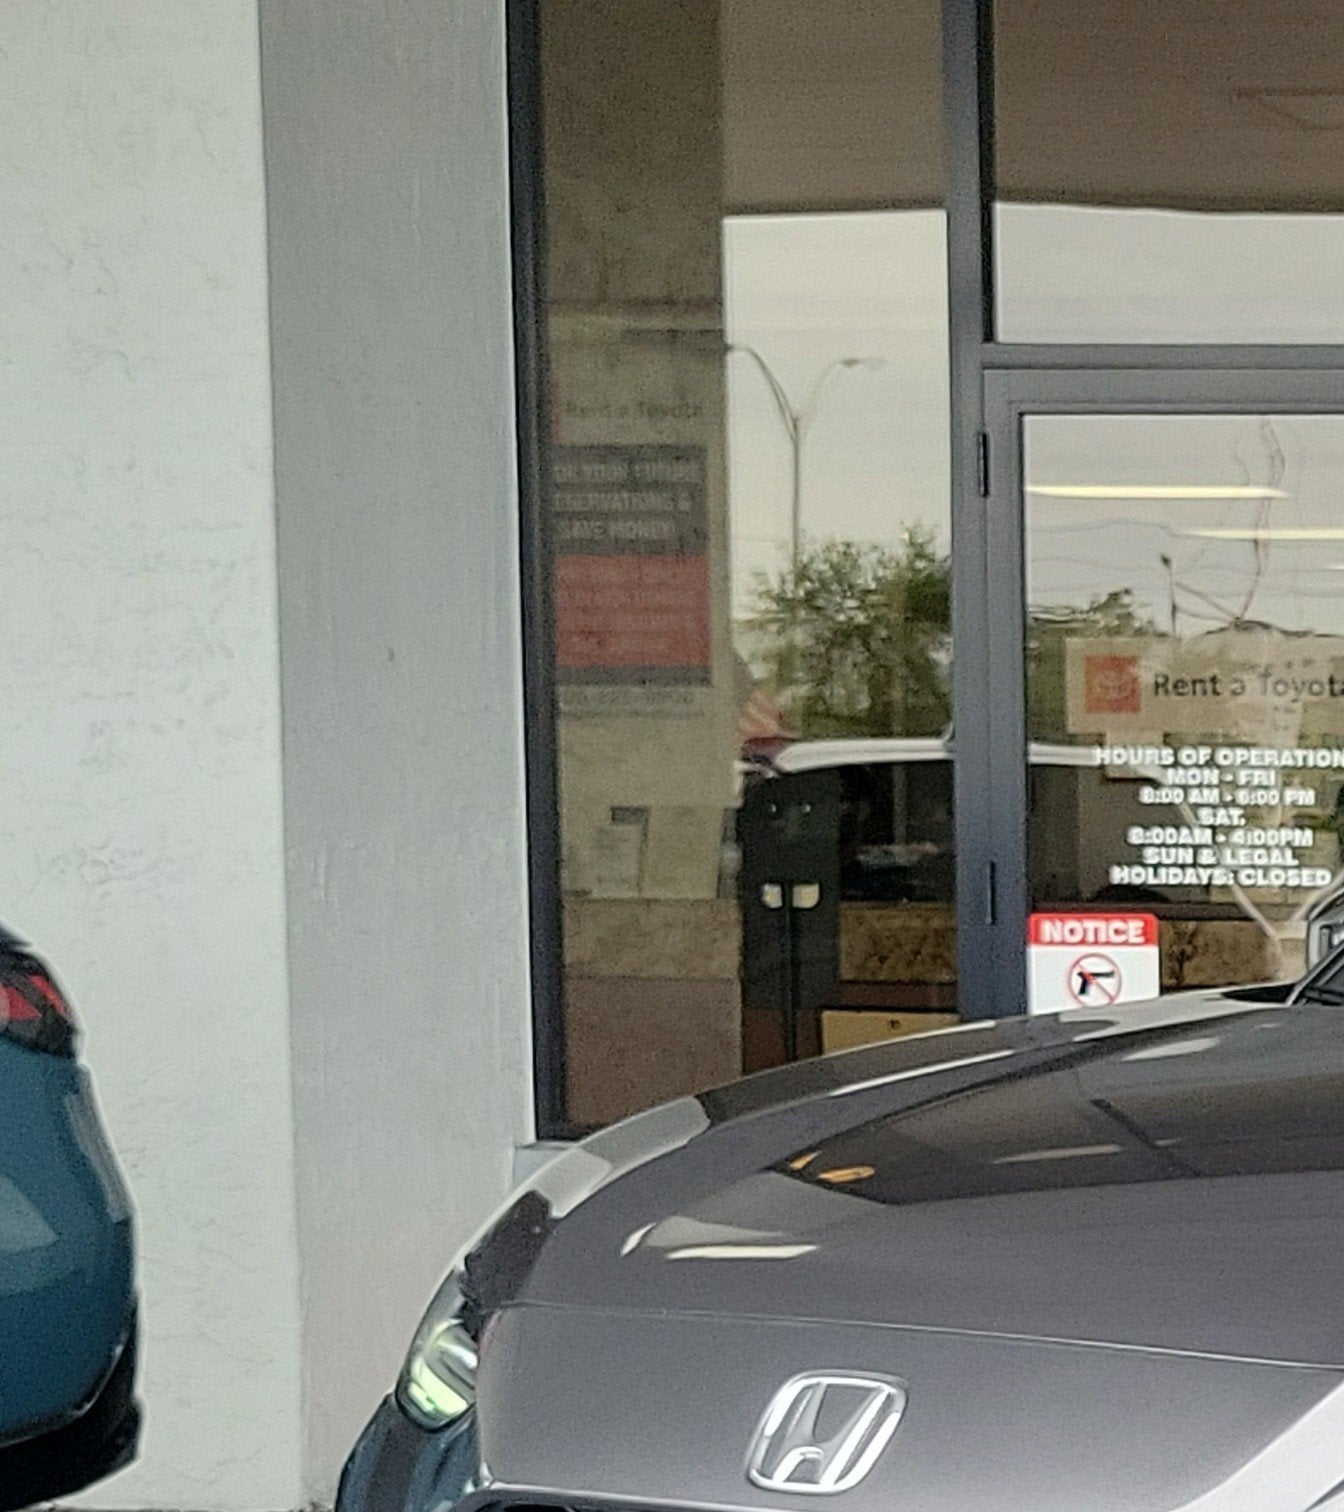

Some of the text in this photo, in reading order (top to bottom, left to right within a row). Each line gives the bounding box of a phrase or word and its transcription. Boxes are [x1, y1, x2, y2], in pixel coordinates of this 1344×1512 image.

[1153, 672, 1222, 697] Rent
[1230, 679, 1247, 697] a
[1096, 746, 1175, 767] HOURS
[1177, 747, 1212, 767] OF
[1167, 767, 1221, 786] MON
[1236, 769, 1277, 786] FRI
[1186, 787, 1221, 805] AM
[1282, 788, 1316, 806] PM
[1197, 807, 1247, 826] SAT.
[1228, 828, 1314, 848] 4:00PM
[1142, 847, 1300, 867] SUN & LEGAL
[1109, 865, 1332, 888] HOLIDAYS: CLOSED
[1040, 917, 1146, 944] NOTICE
